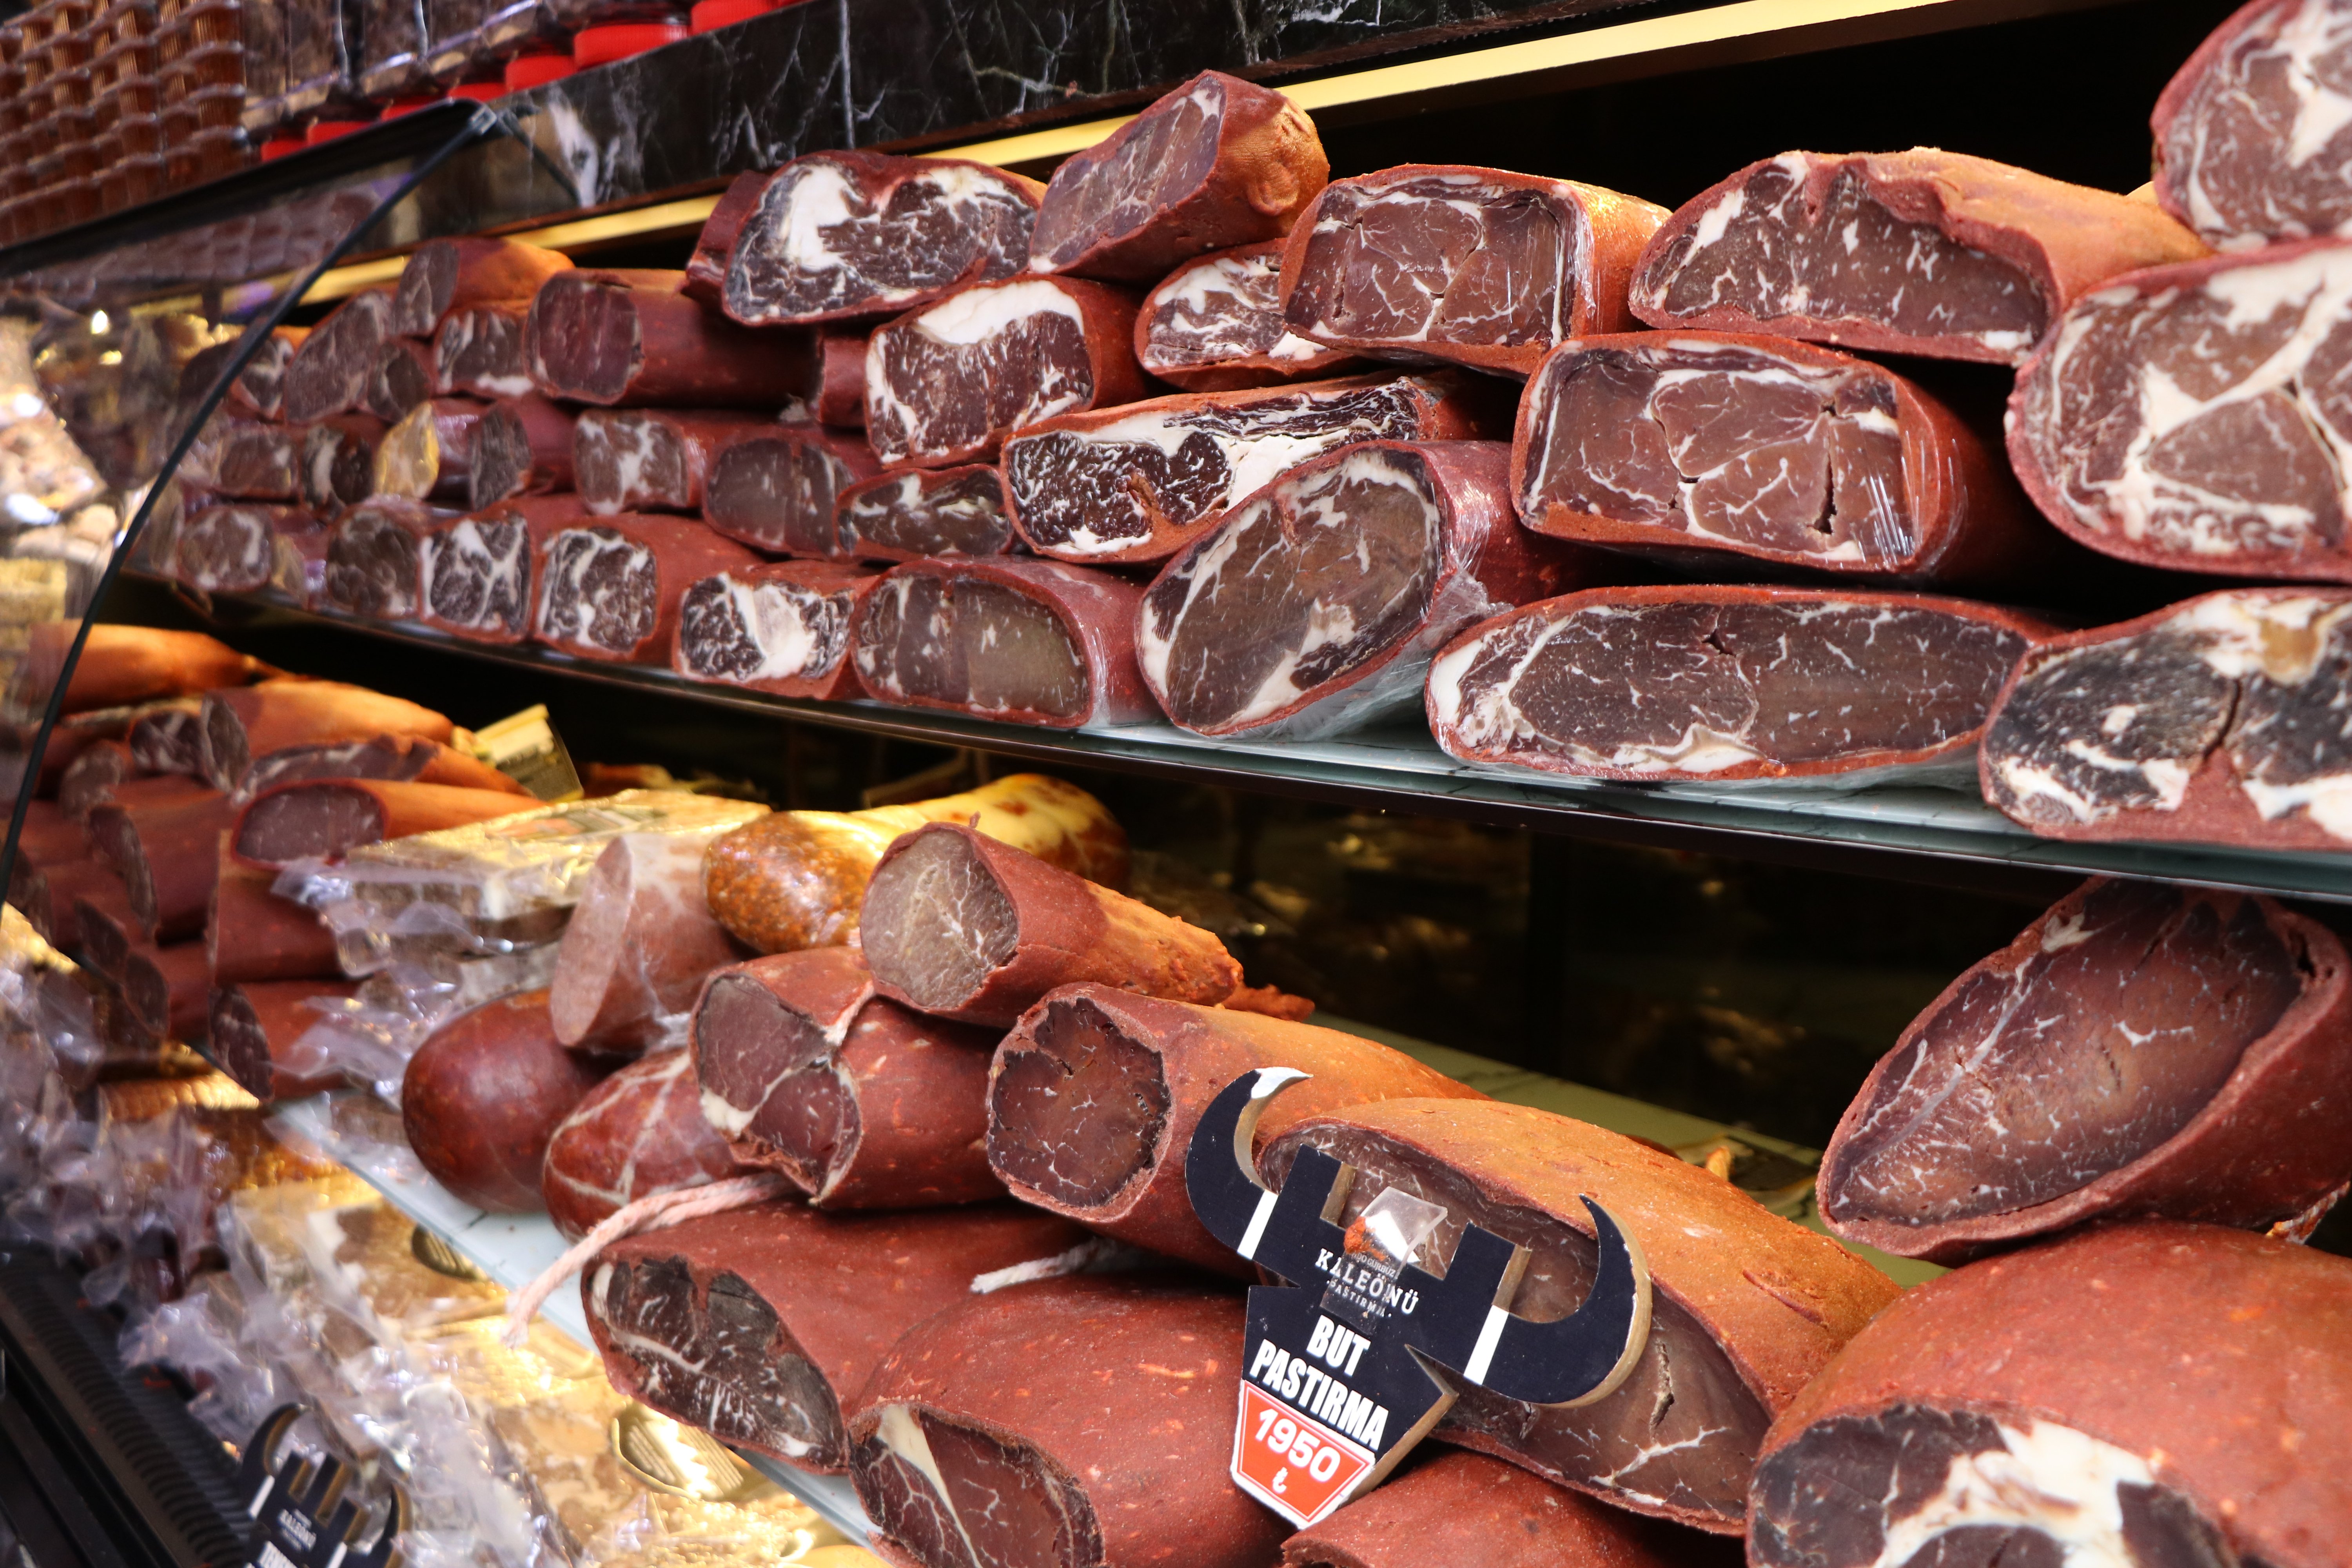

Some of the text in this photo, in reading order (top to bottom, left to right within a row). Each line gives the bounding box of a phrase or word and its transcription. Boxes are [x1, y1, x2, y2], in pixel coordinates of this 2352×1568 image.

[1315, 1248, 1419, 1314] KALEÖNÜ
[1367, 1258, 1396, 1277] GÜRBÜZ
[1307, 1314, 1371, 1377] BUT
[1249, 1339, 1388, 1451] PASTIRMA
[1255, 1408, 1341, 1482] 1950
